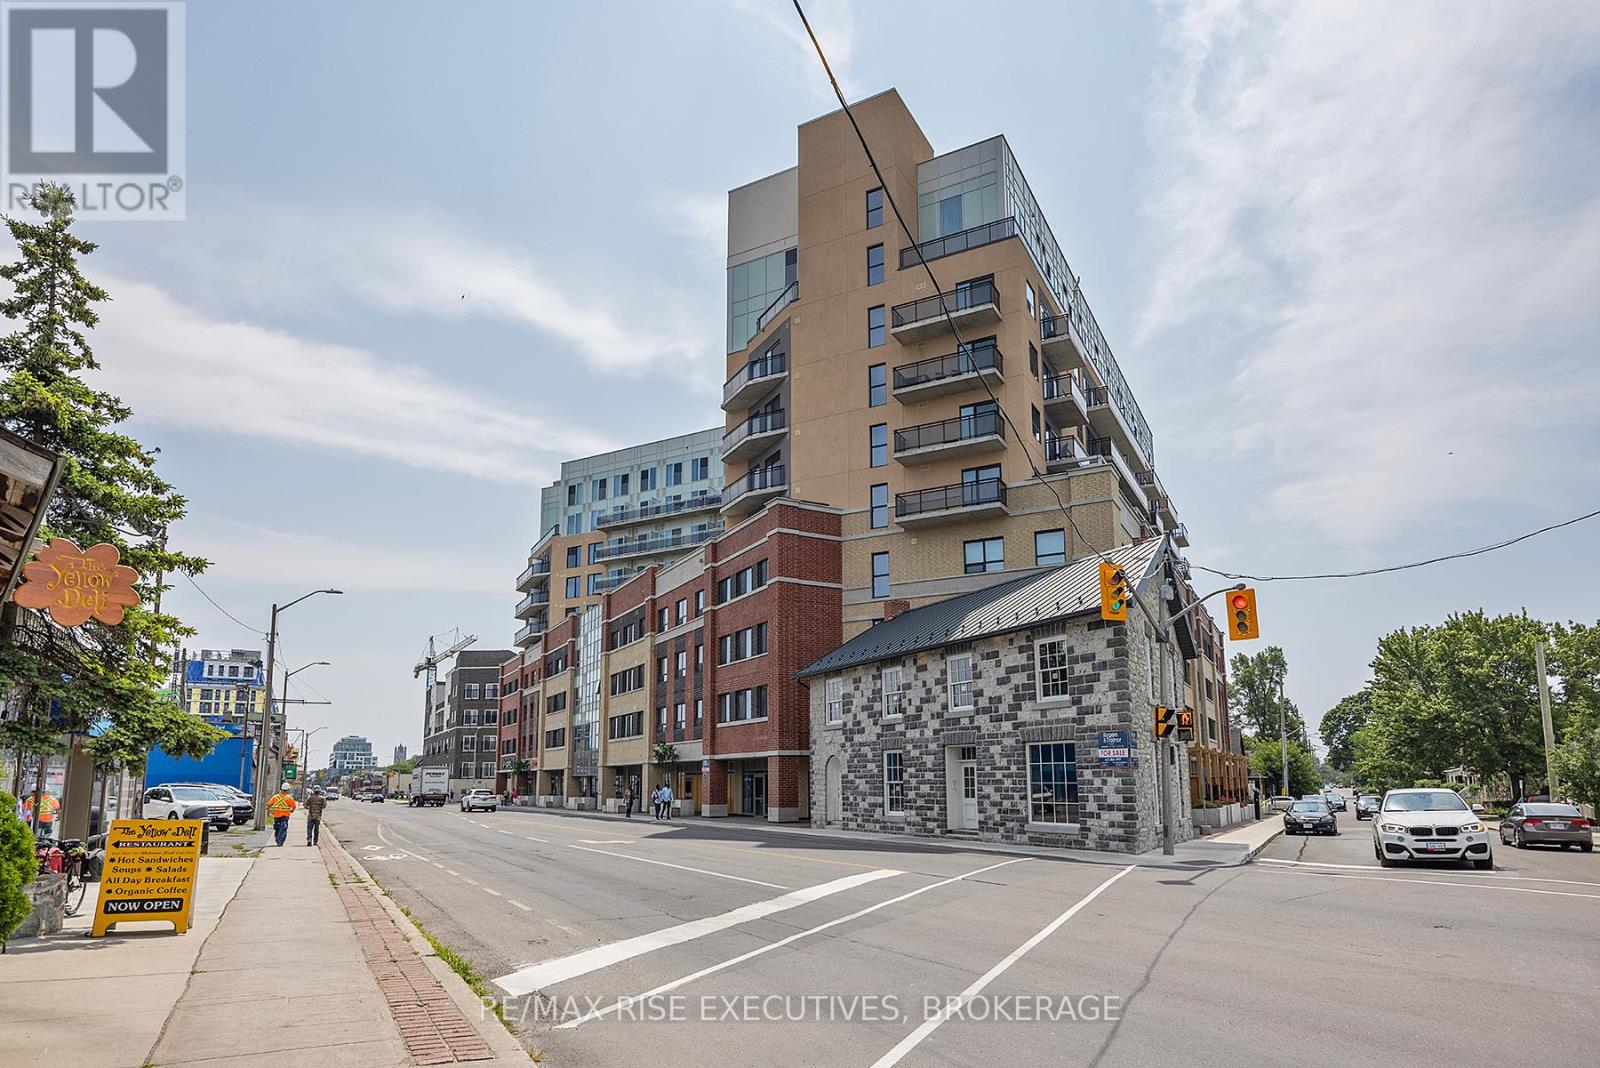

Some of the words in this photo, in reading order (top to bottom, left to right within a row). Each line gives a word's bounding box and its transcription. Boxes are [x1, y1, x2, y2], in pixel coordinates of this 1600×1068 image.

[47, 564, 119, 593] Yellow
[55, 588, 109, 615] Deli
[113, 826, 136, 835] The
[137, 824, 172, 839] Yellow
[172, 826, 198, 839] Deli
[138, 856, 194, 864] Sandwiches
[112, 866, 142, 874] Soups
[105, 877, 120, 885] All
[122, 877, 142, 885] Day
[144, 876, 190, 884] Breakfast
[115, 888, 154, 896] Organic
[157, 886, 188, 895] Coffee
[107, 902, 140, 912] NOW
[143, 900, 181, 911] OPEN
